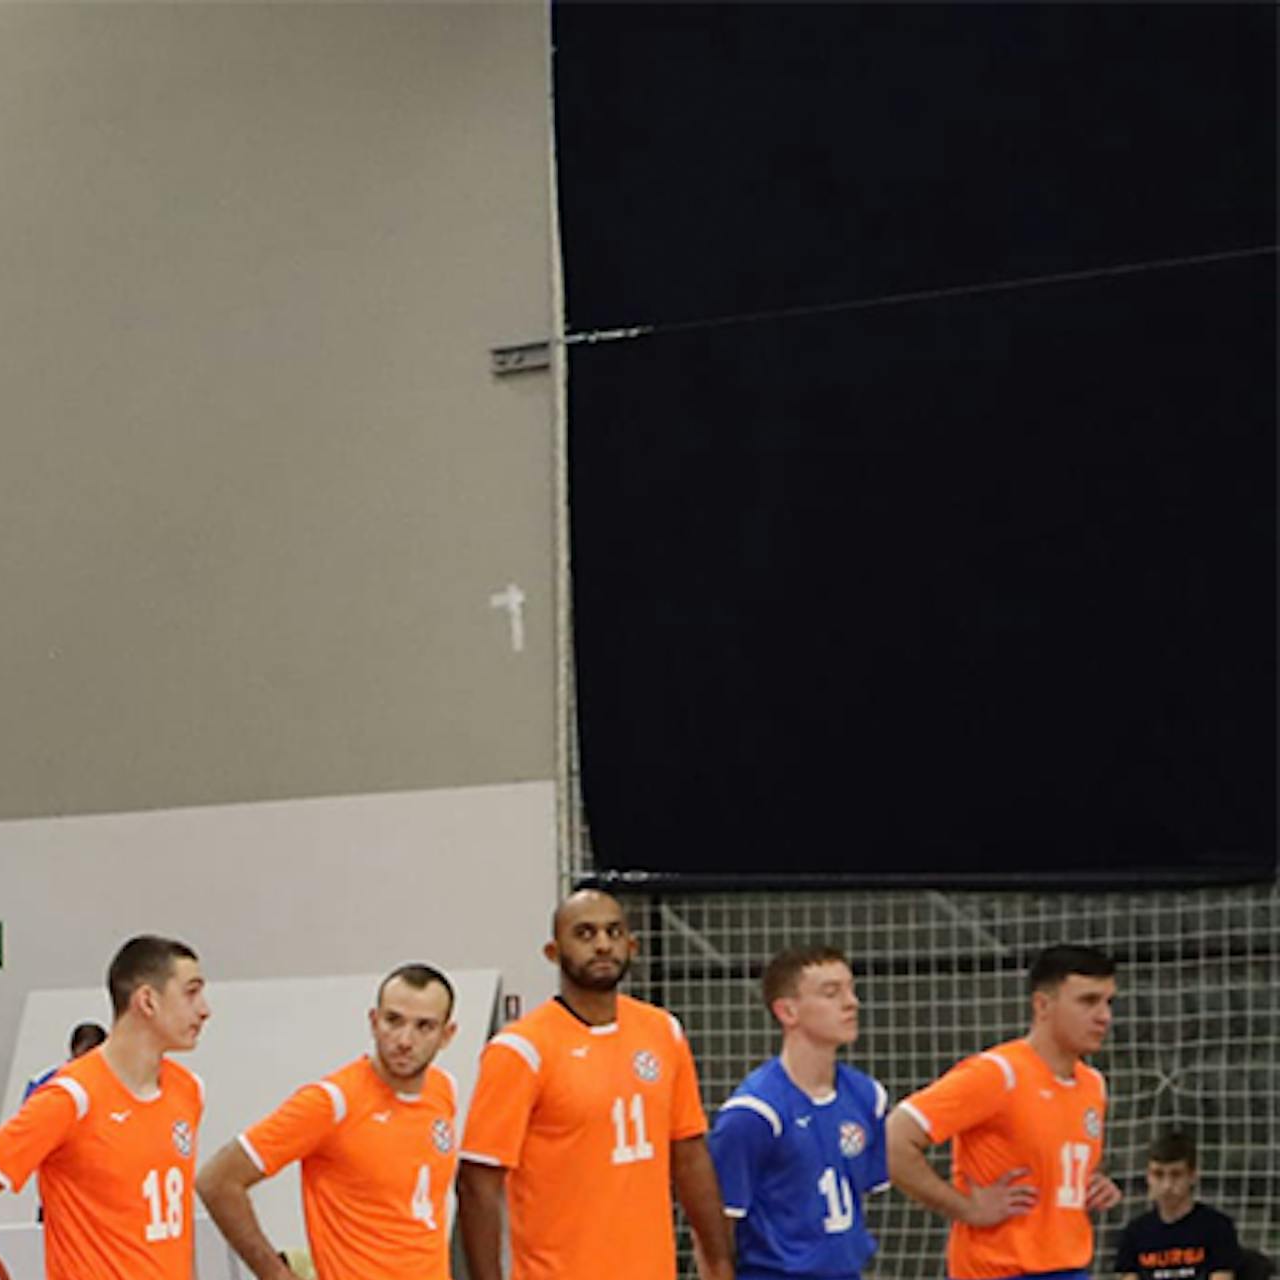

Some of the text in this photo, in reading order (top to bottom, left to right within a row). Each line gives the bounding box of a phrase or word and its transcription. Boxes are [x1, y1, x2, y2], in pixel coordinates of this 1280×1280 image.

[609, 1093, 655, 1165] 11
[142, 1166, 185, 1242] 18
[410, 1163, 438, 1231] 4
[1056, 1141, 1092, 1209] 17
